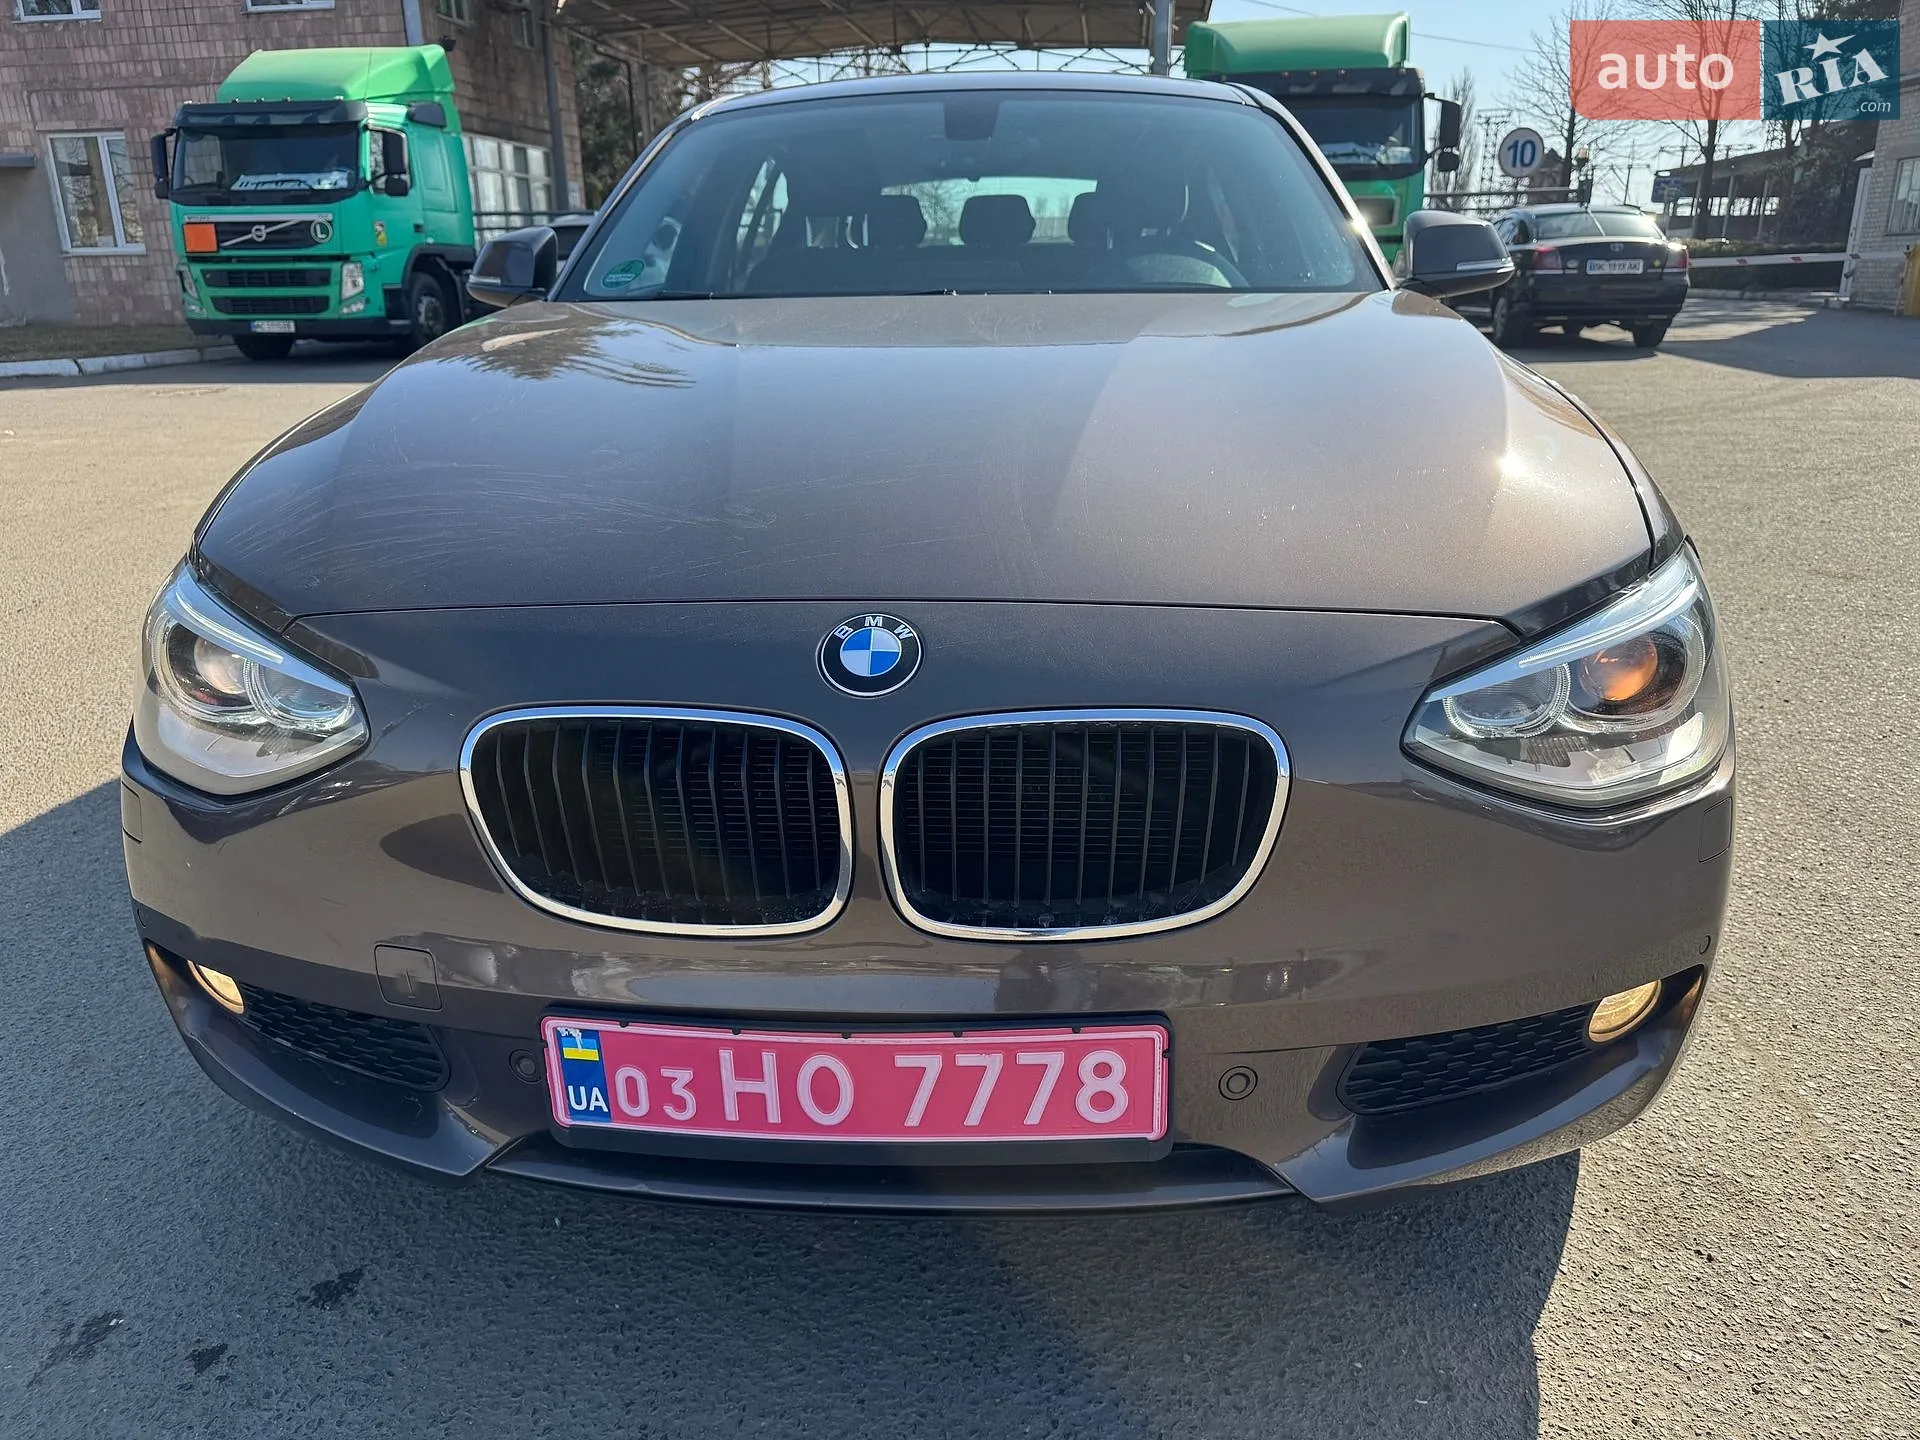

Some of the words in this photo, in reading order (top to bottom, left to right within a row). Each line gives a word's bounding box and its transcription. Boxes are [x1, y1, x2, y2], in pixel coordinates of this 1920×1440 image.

[1507, 140, 1536, 169] 10
[834, 615, 914, 640] BMW
[567, 1085, 609, 1112] UA
[614, 1066, 698, 1121] 03
[718, 1048, 855, 1126] HO
[894, 1049, 1129, 1127] 7778
